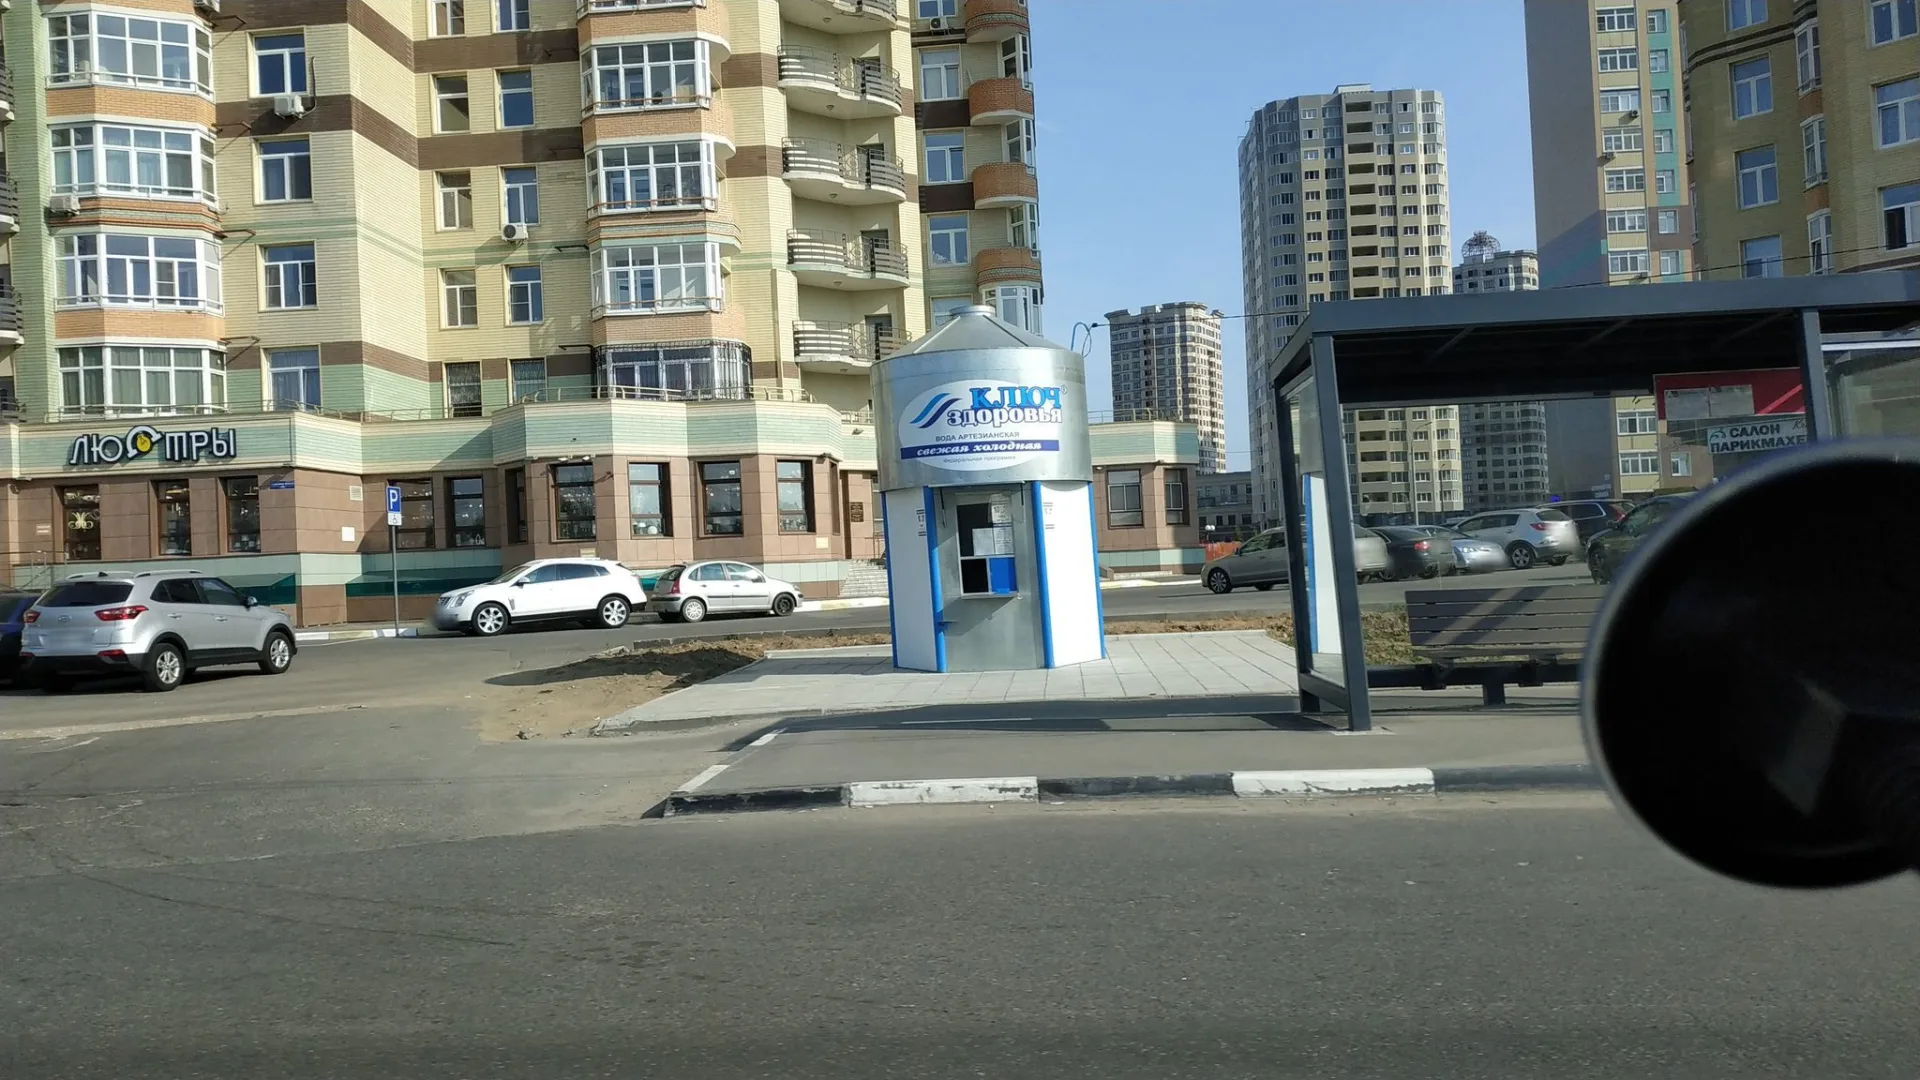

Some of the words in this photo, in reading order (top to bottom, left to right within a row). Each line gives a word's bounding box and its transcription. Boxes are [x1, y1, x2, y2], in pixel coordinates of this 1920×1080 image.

[969, 386, 1062, 408] КЛЮЧ
[935, 434, 956, 442] ВОДА
[958, 431, 1020, 441] АРТЕЗИАНСКАЯ
[1729, 423, 1781, 438] САЛОН
[916, 446, 969, 457] свежая
[972, 441, 1042, 453] холодная
[390, 489, 398, 510] P
